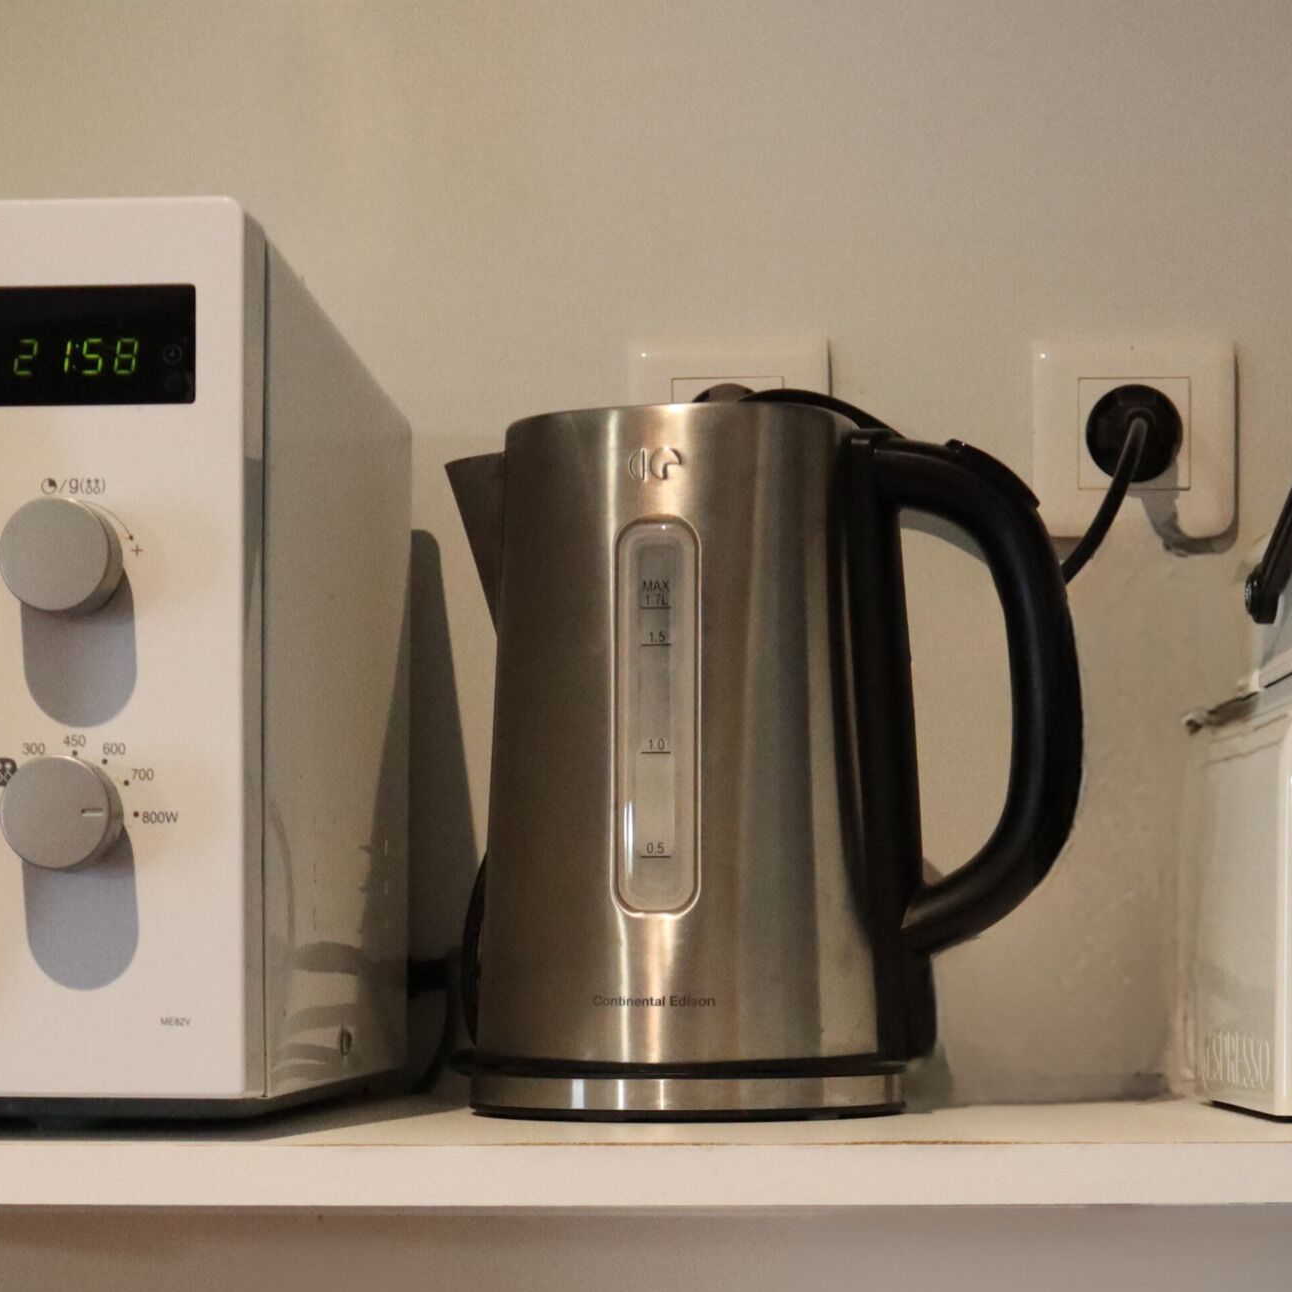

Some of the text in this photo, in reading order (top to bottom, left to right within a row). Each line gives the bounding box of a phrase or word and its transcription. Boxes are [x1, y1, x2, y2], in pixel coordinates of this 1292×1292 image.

[642, 580, 670, 593] MAX
[644, 594, 670, 606] 1.7L
[648, 632, 666, 643] 1.5
[63, 735, 86, 747] 450
[648, 739, 665, 751] 1.0
[22, 743, 46, 755] 300
[102, 743, 126, 755] 600
[131, 769, 154, 781] 700
[142, 811, 178, 824] 800W
[646, 843, 665, 855] 0.5
[592, 995, 716, 1007] Continental Edison
